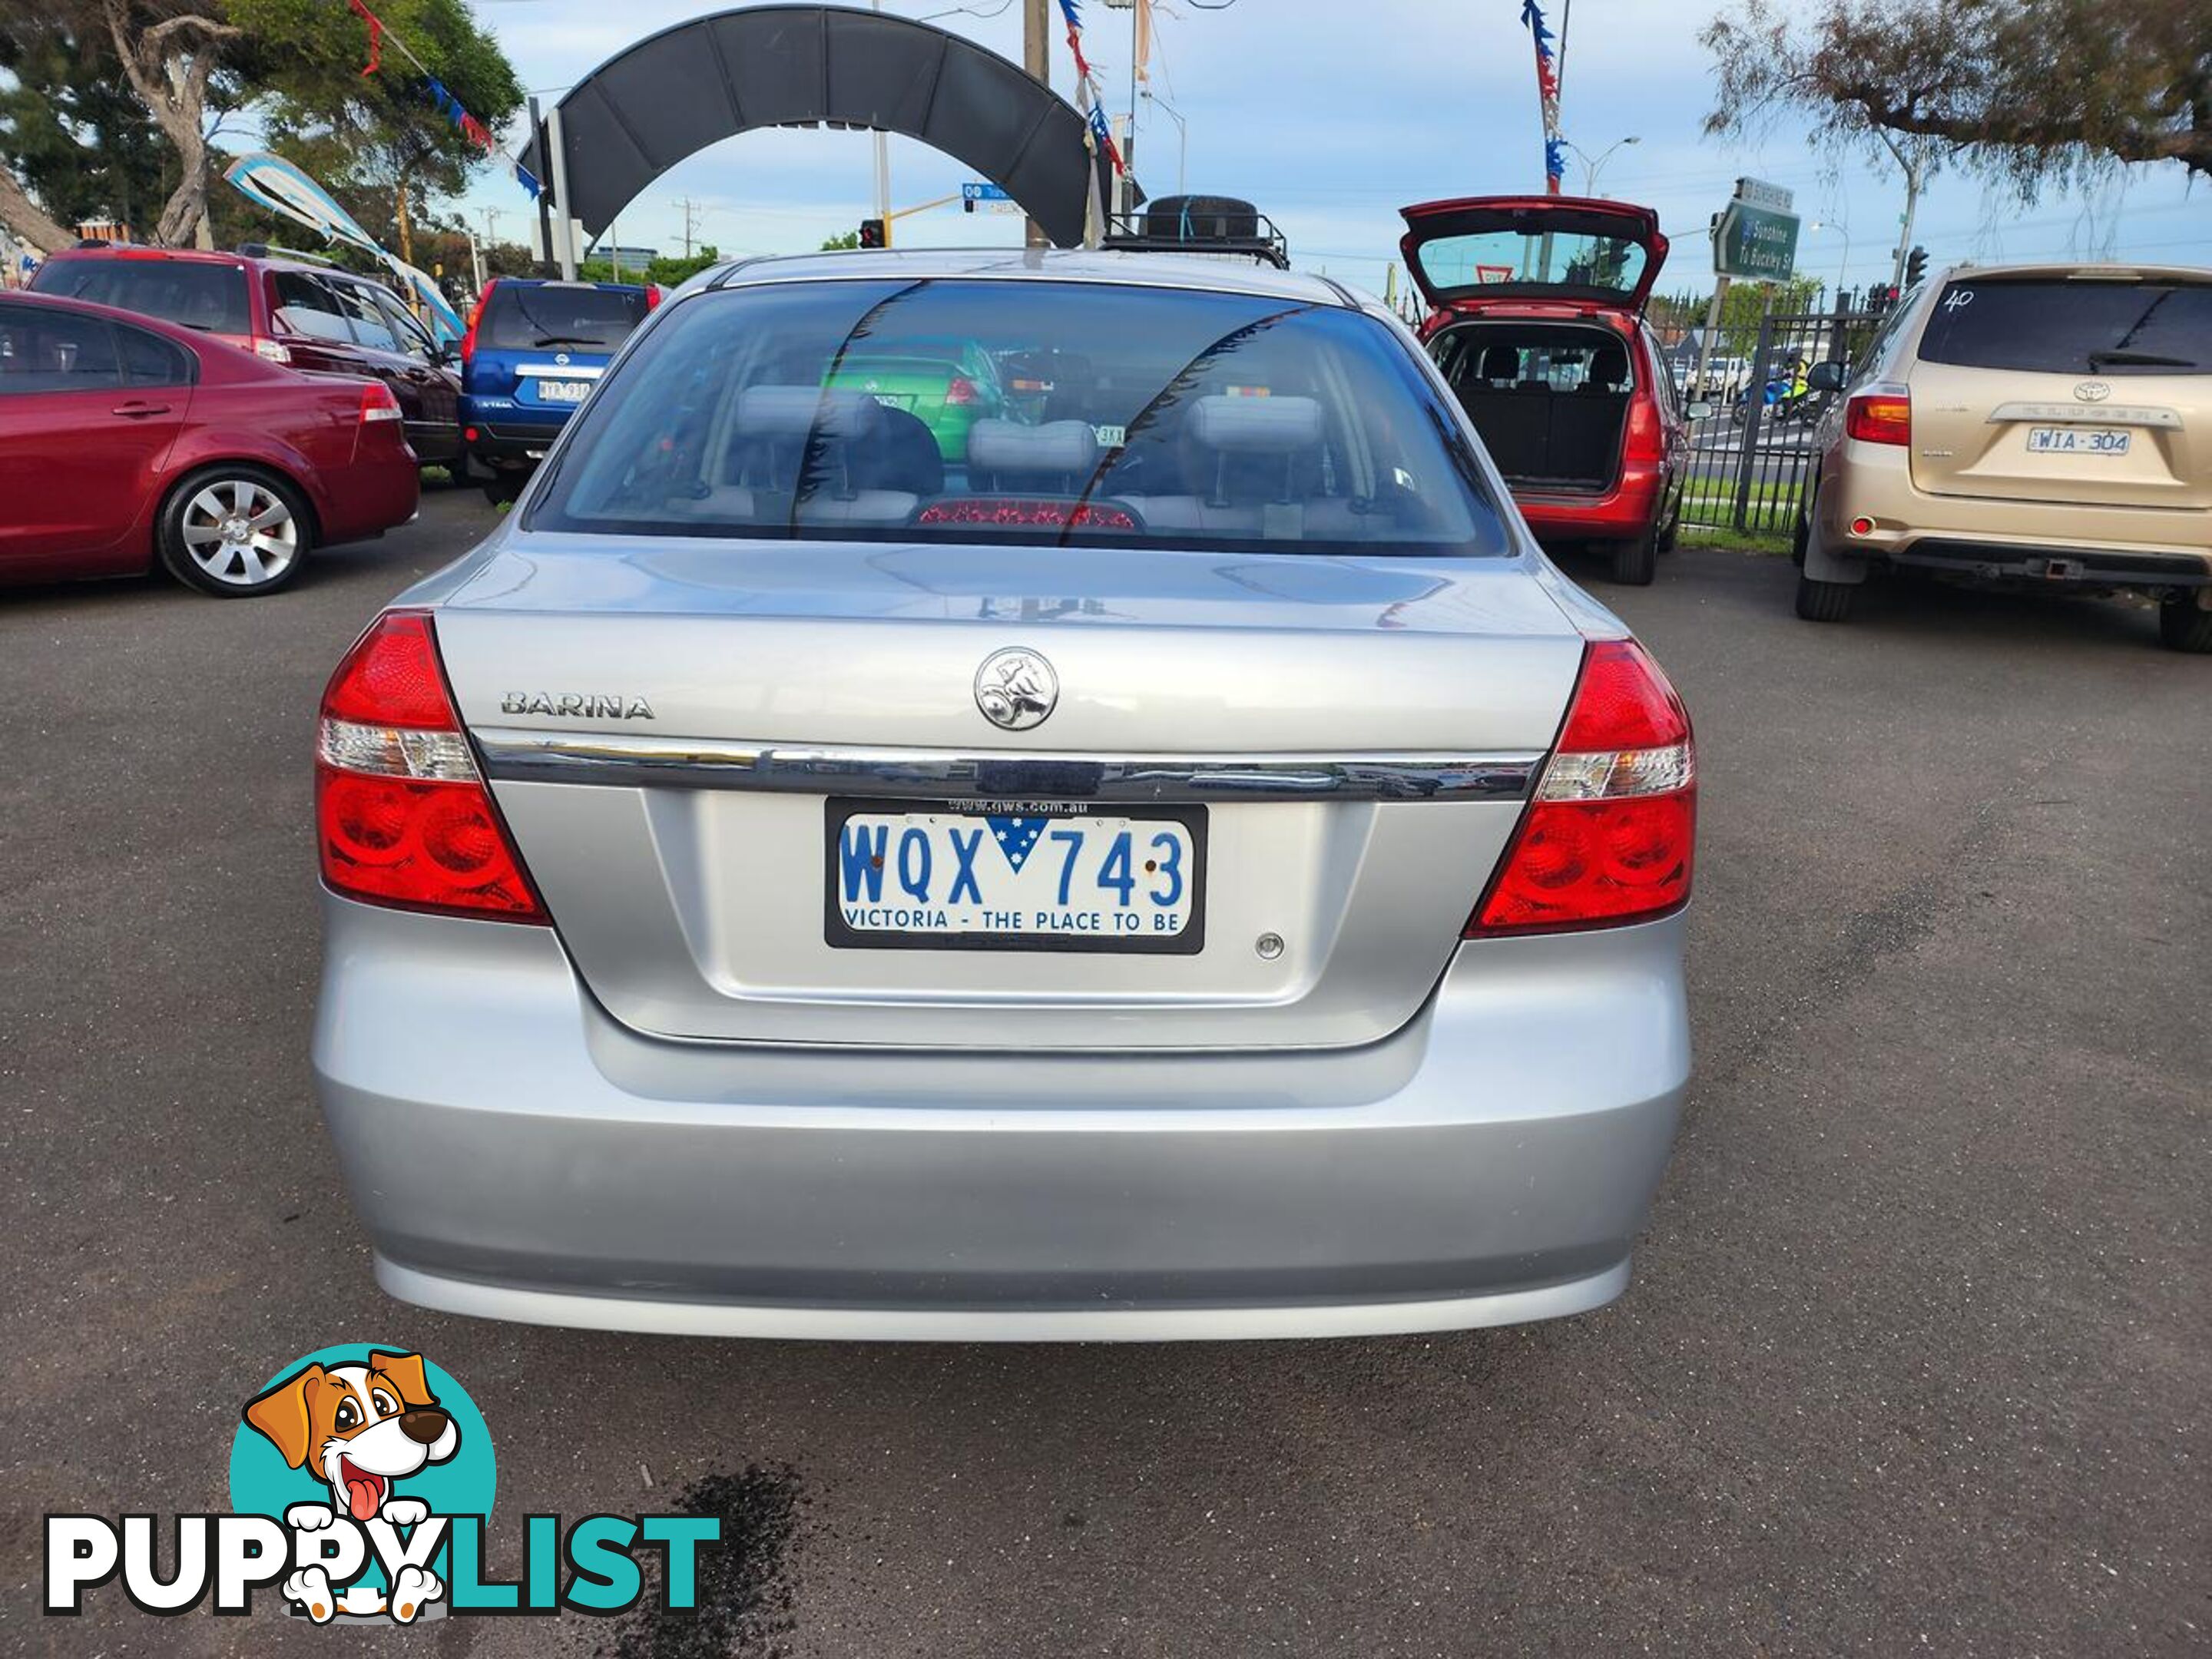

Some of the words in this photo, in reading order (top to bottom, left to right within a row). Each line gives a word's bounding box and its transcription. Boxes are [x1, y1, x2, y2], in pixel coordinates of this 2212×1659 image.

[1753, 220, 1787, 243] Sunshine
[1751, 247, 1781, 271] Buckley
[1944, 290, 1974, 311] 40
[502, 691, 656, 719] BARINA
[948, 800, 1088, 814] www.gws.com.au
[844, 824, 983, 905] WQX
[1051, 830, 1183, 907] 743
[845, 909, 949, 928] VICTORIA
[983, 912, 1022, 929] THE
[1036, 912, 1100, 931] PLACE
[1115, 914, 1140, 931] TO
[1154, 914, 1178, 931] BE
